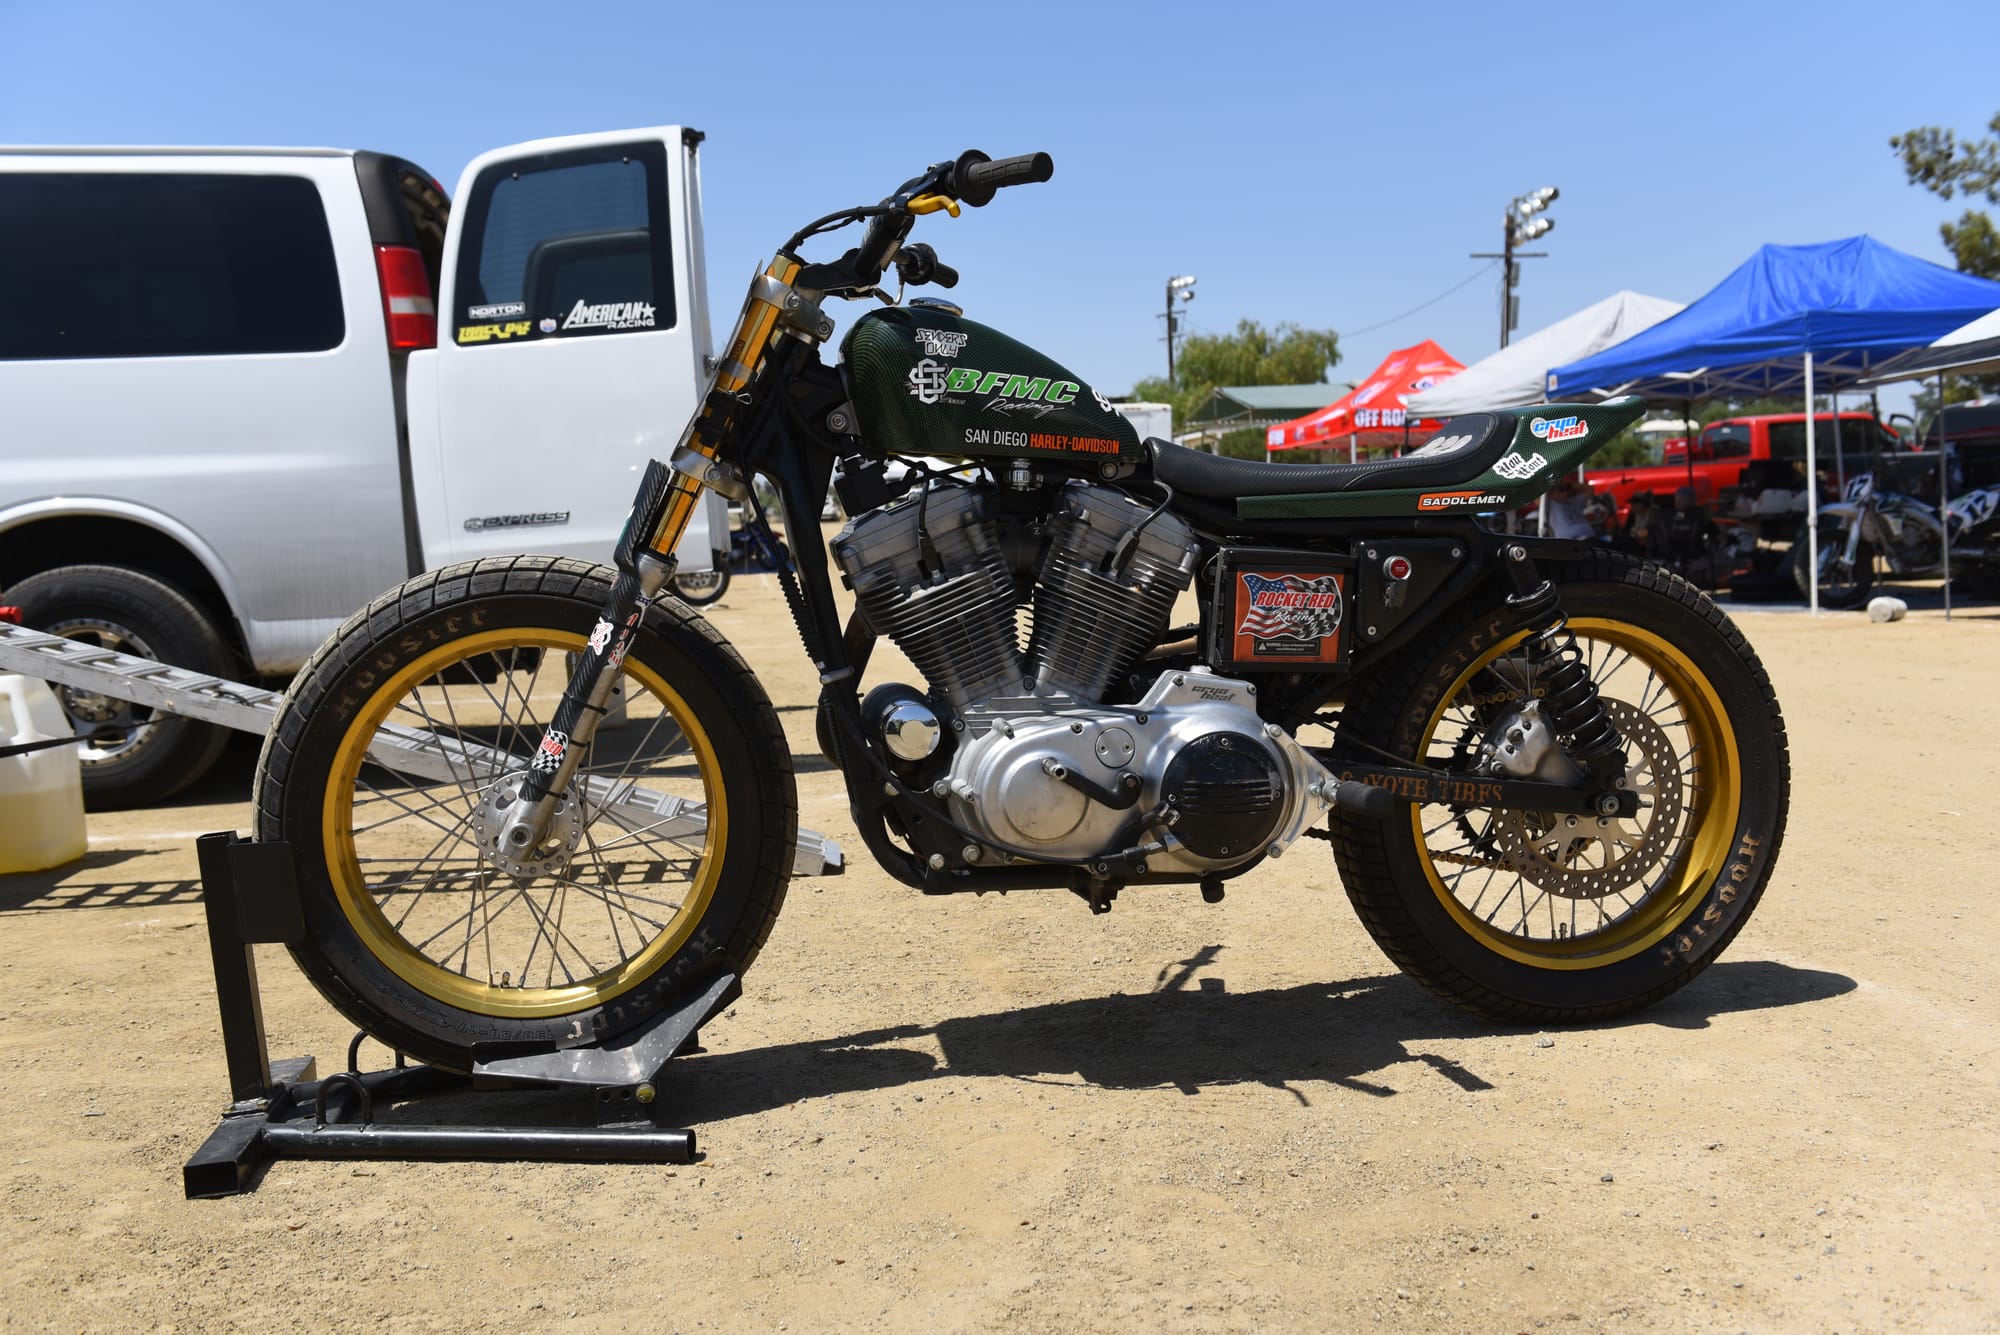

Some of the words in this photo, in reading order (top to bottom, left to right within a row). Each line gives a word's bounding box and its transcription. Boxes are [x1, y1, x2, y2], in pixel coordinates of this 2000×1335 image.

[470, 304, 523, 317] NORTON
[562, 299, 643, 329] AMERICAN
[607, 318, 655, 329] RACING
[946, 367, 1080, 403] BFMC
[981, 398, 1064, 419] Racing
[1355, 408, 1378, 427] OFF
[1548, 420, 1586, 439] heat
[965, 428, 992, 445] SAN
[993, 431, 1028, 448] DIEGO
[1030, 433, 1120, 454] HARLEY-DAVIDSON
[1422, 495, 1506, 507] SADDLEMEN
[483, 510, 570, 527] EXPRESS
[1256, 591, 1308, 608] ROCKET
[1307, 593, 1336, 608] RED
[1273, 608, 1315, 625] Racing
